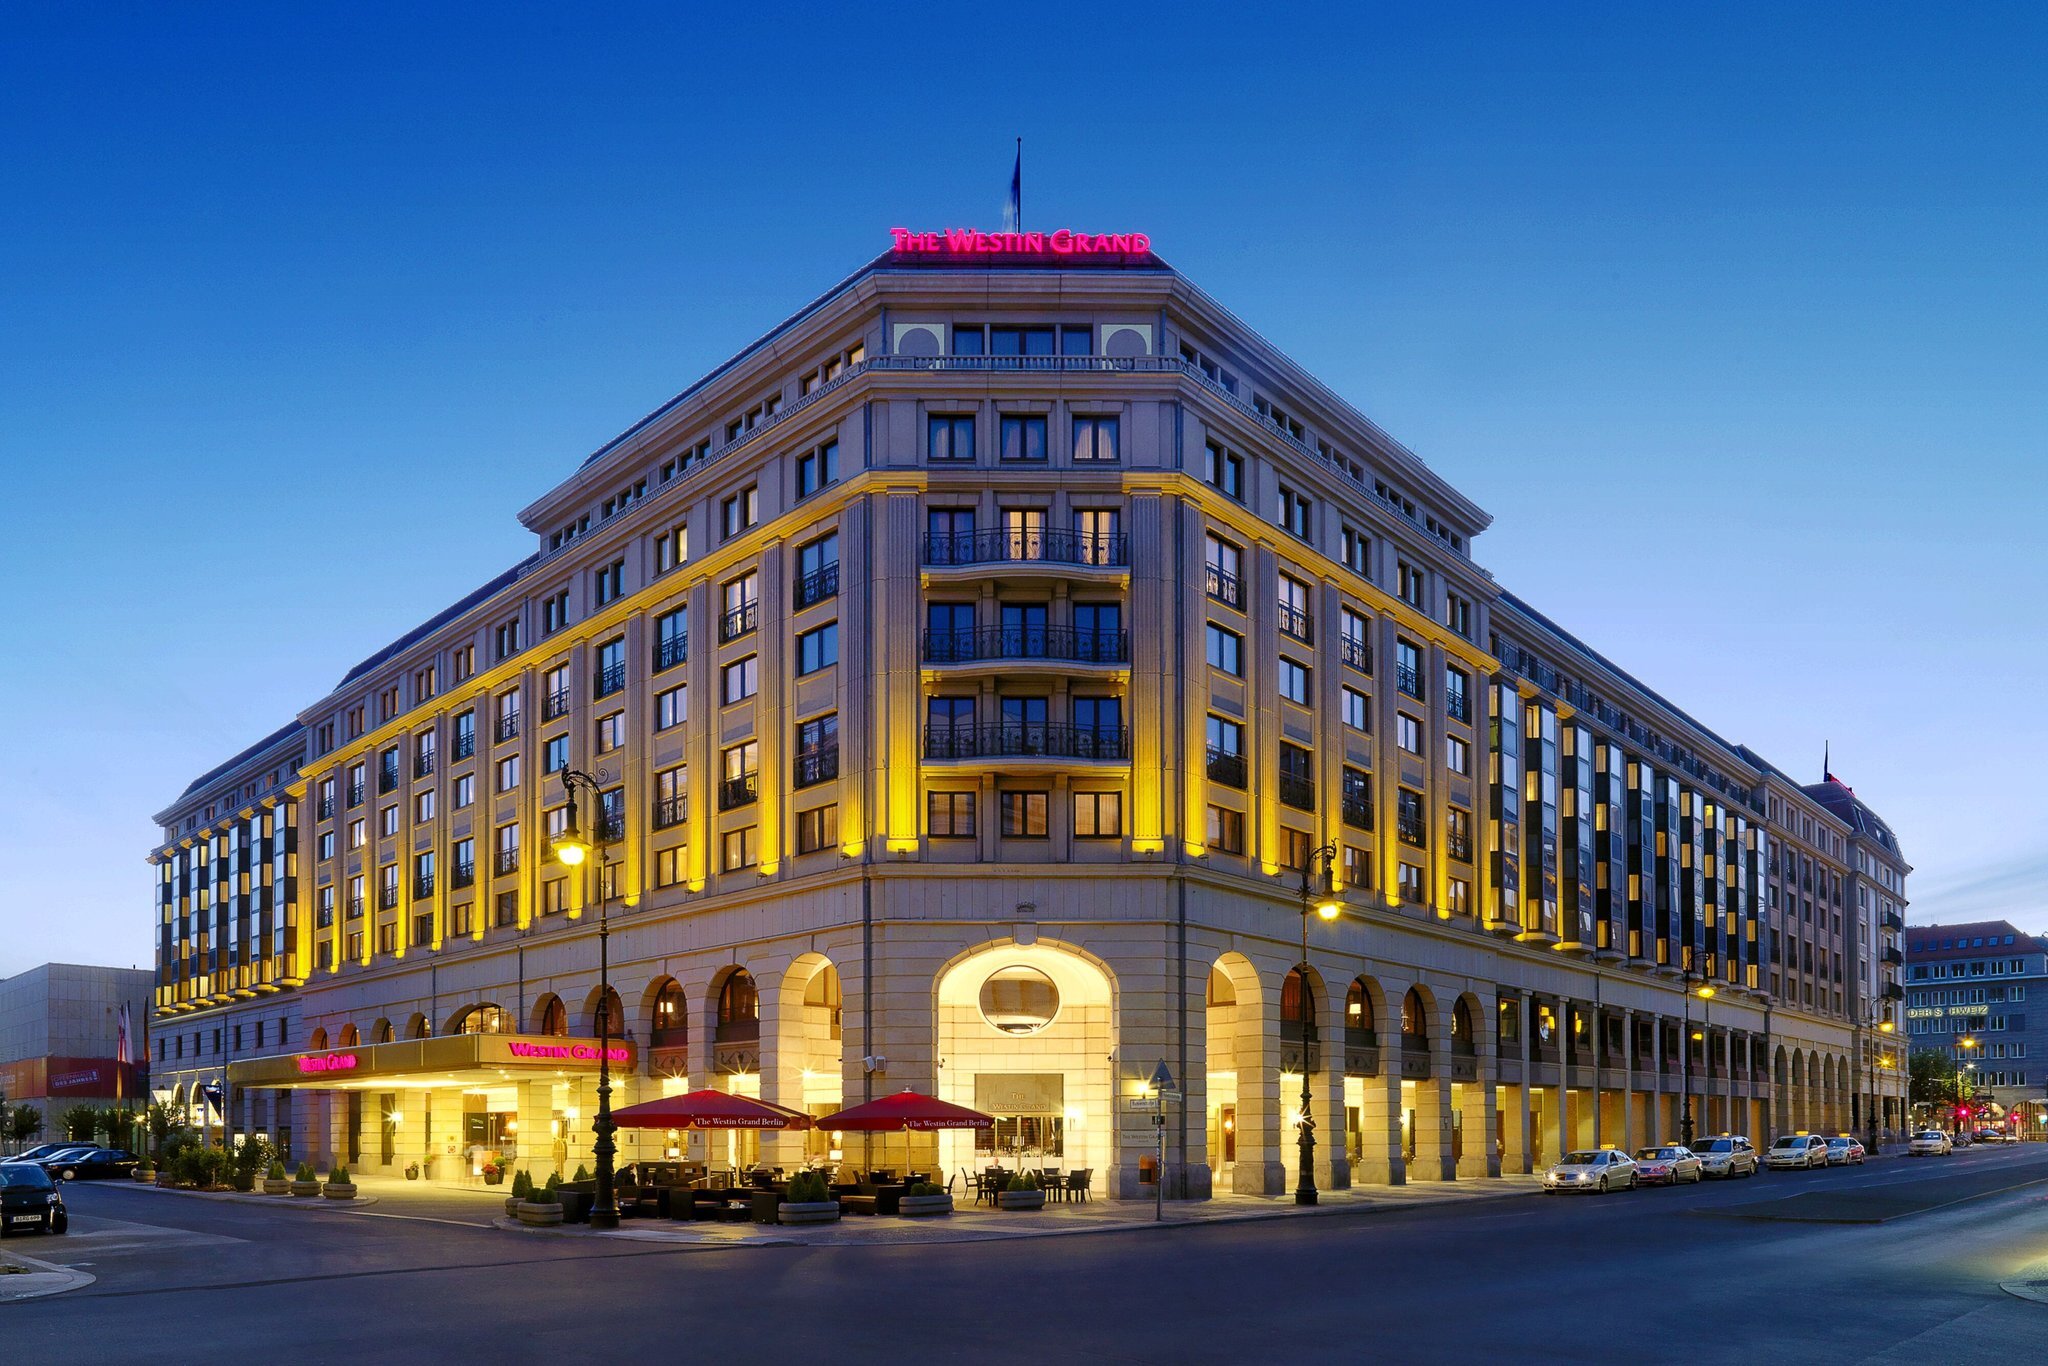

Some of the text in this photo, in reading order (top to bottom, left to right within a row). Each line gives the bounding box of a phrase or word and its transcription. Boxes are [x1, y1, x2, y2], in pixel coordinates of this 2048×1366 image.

[890, 228, 1151, 254] THE WESTIN GRAND
[1909, 1008, 1931, 1018] DER
[509, 1042, 569, 1059] WESTIN
[696, 1117, 784, 1126] The Westin Grand Berlin
[946, 1119, 968, 1127] Grand
